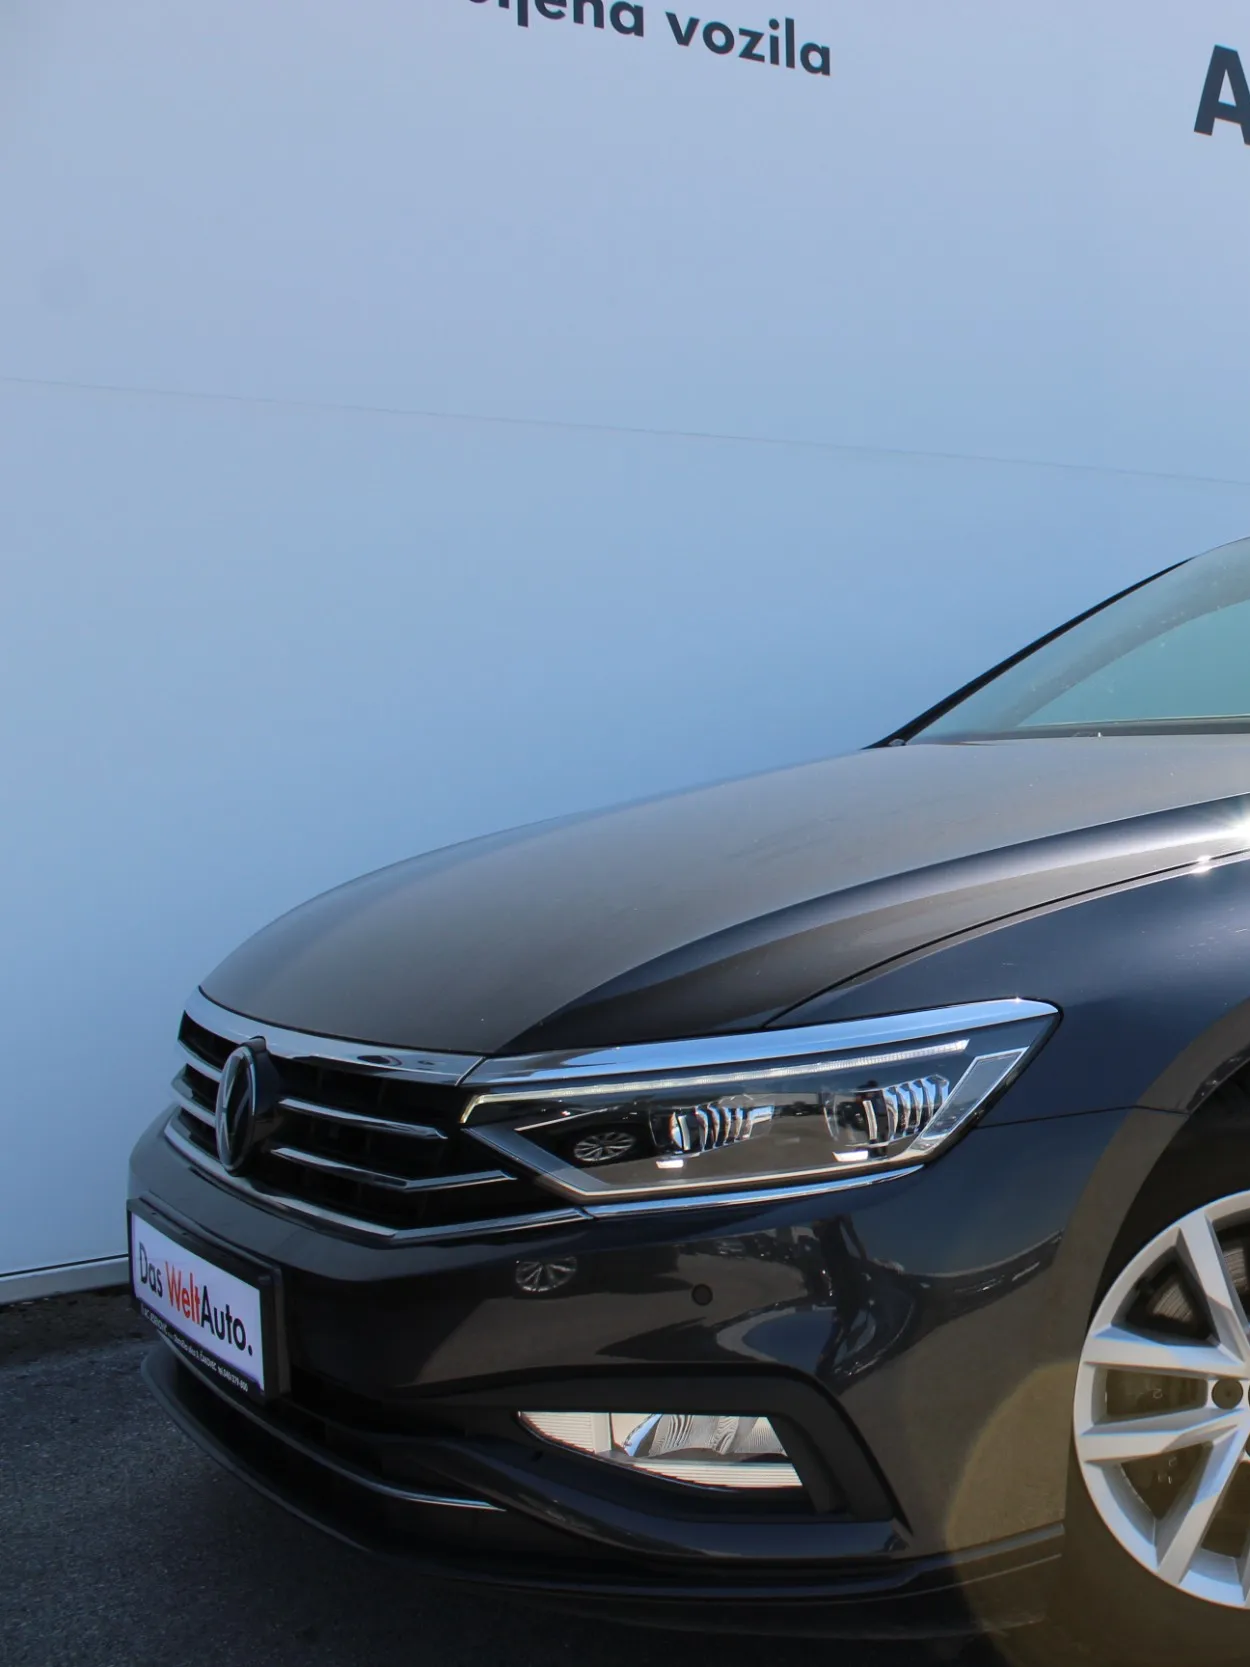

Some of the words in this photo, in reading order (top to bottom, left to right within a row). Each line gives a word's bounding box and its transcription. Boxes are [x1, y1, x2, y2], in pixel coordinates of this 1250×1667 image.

[666, 12, 830, 76] vozila
[138, 1241, 163, 1298] Das
[164, 1261, 253, 1356] WeltAuto.
